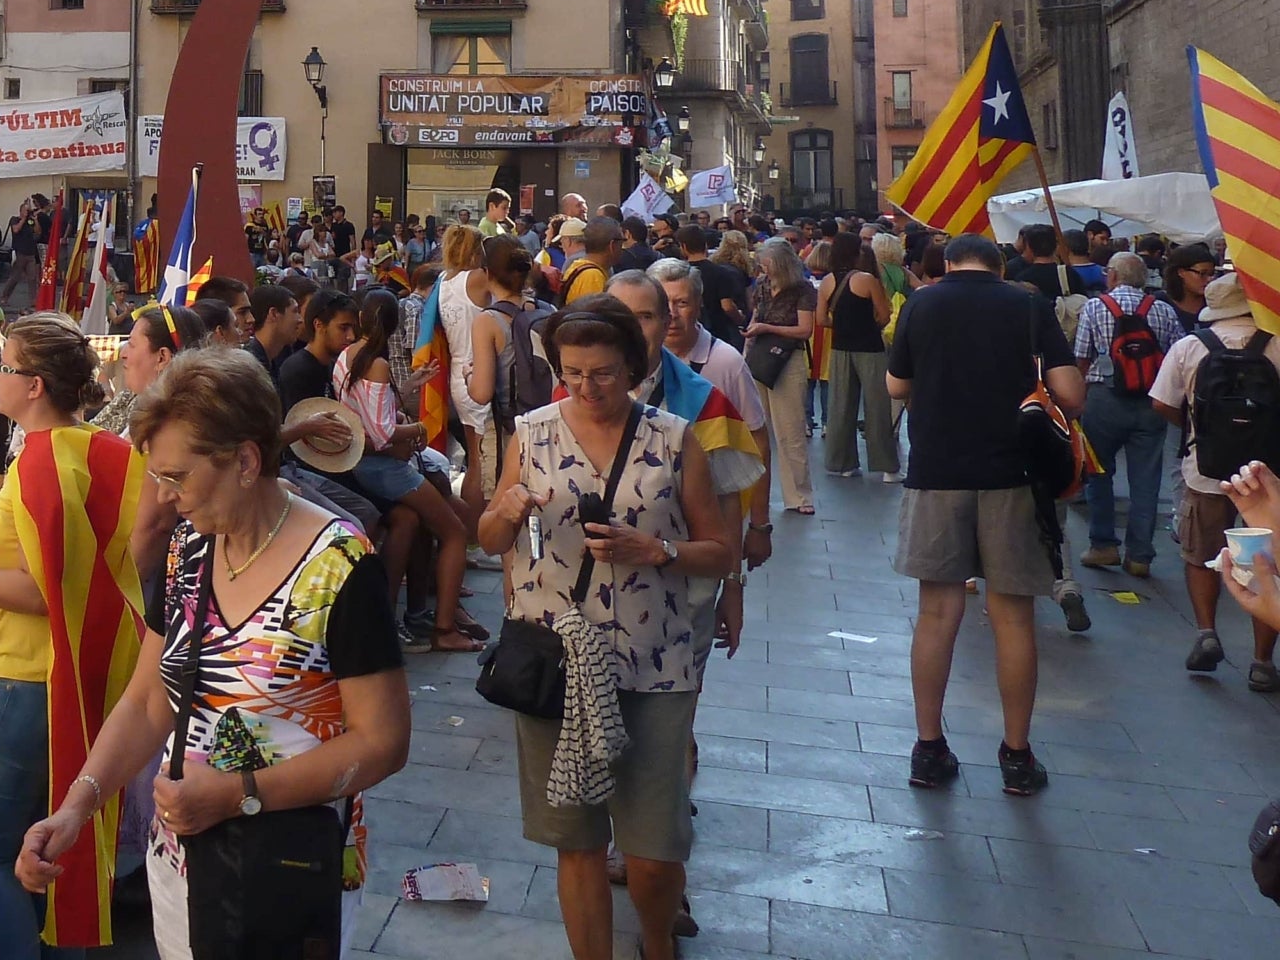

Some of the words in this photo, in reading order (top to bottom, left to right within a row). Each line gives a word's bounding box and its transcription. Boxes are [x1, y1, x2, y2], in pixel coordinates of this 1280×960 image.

[389, 79, 462, 93] CONSTRUIM
[468, 80, 483, 93] LA
[389, 95, 450, 112] UNITAT
[458, 95, 543, 113] POPULAR
[475, 130, 533, 142] endavant
[24, 141, 125, 161] continua
[432, 149, 460, 160] JACK
[463, 149, 496, 159] BORN
